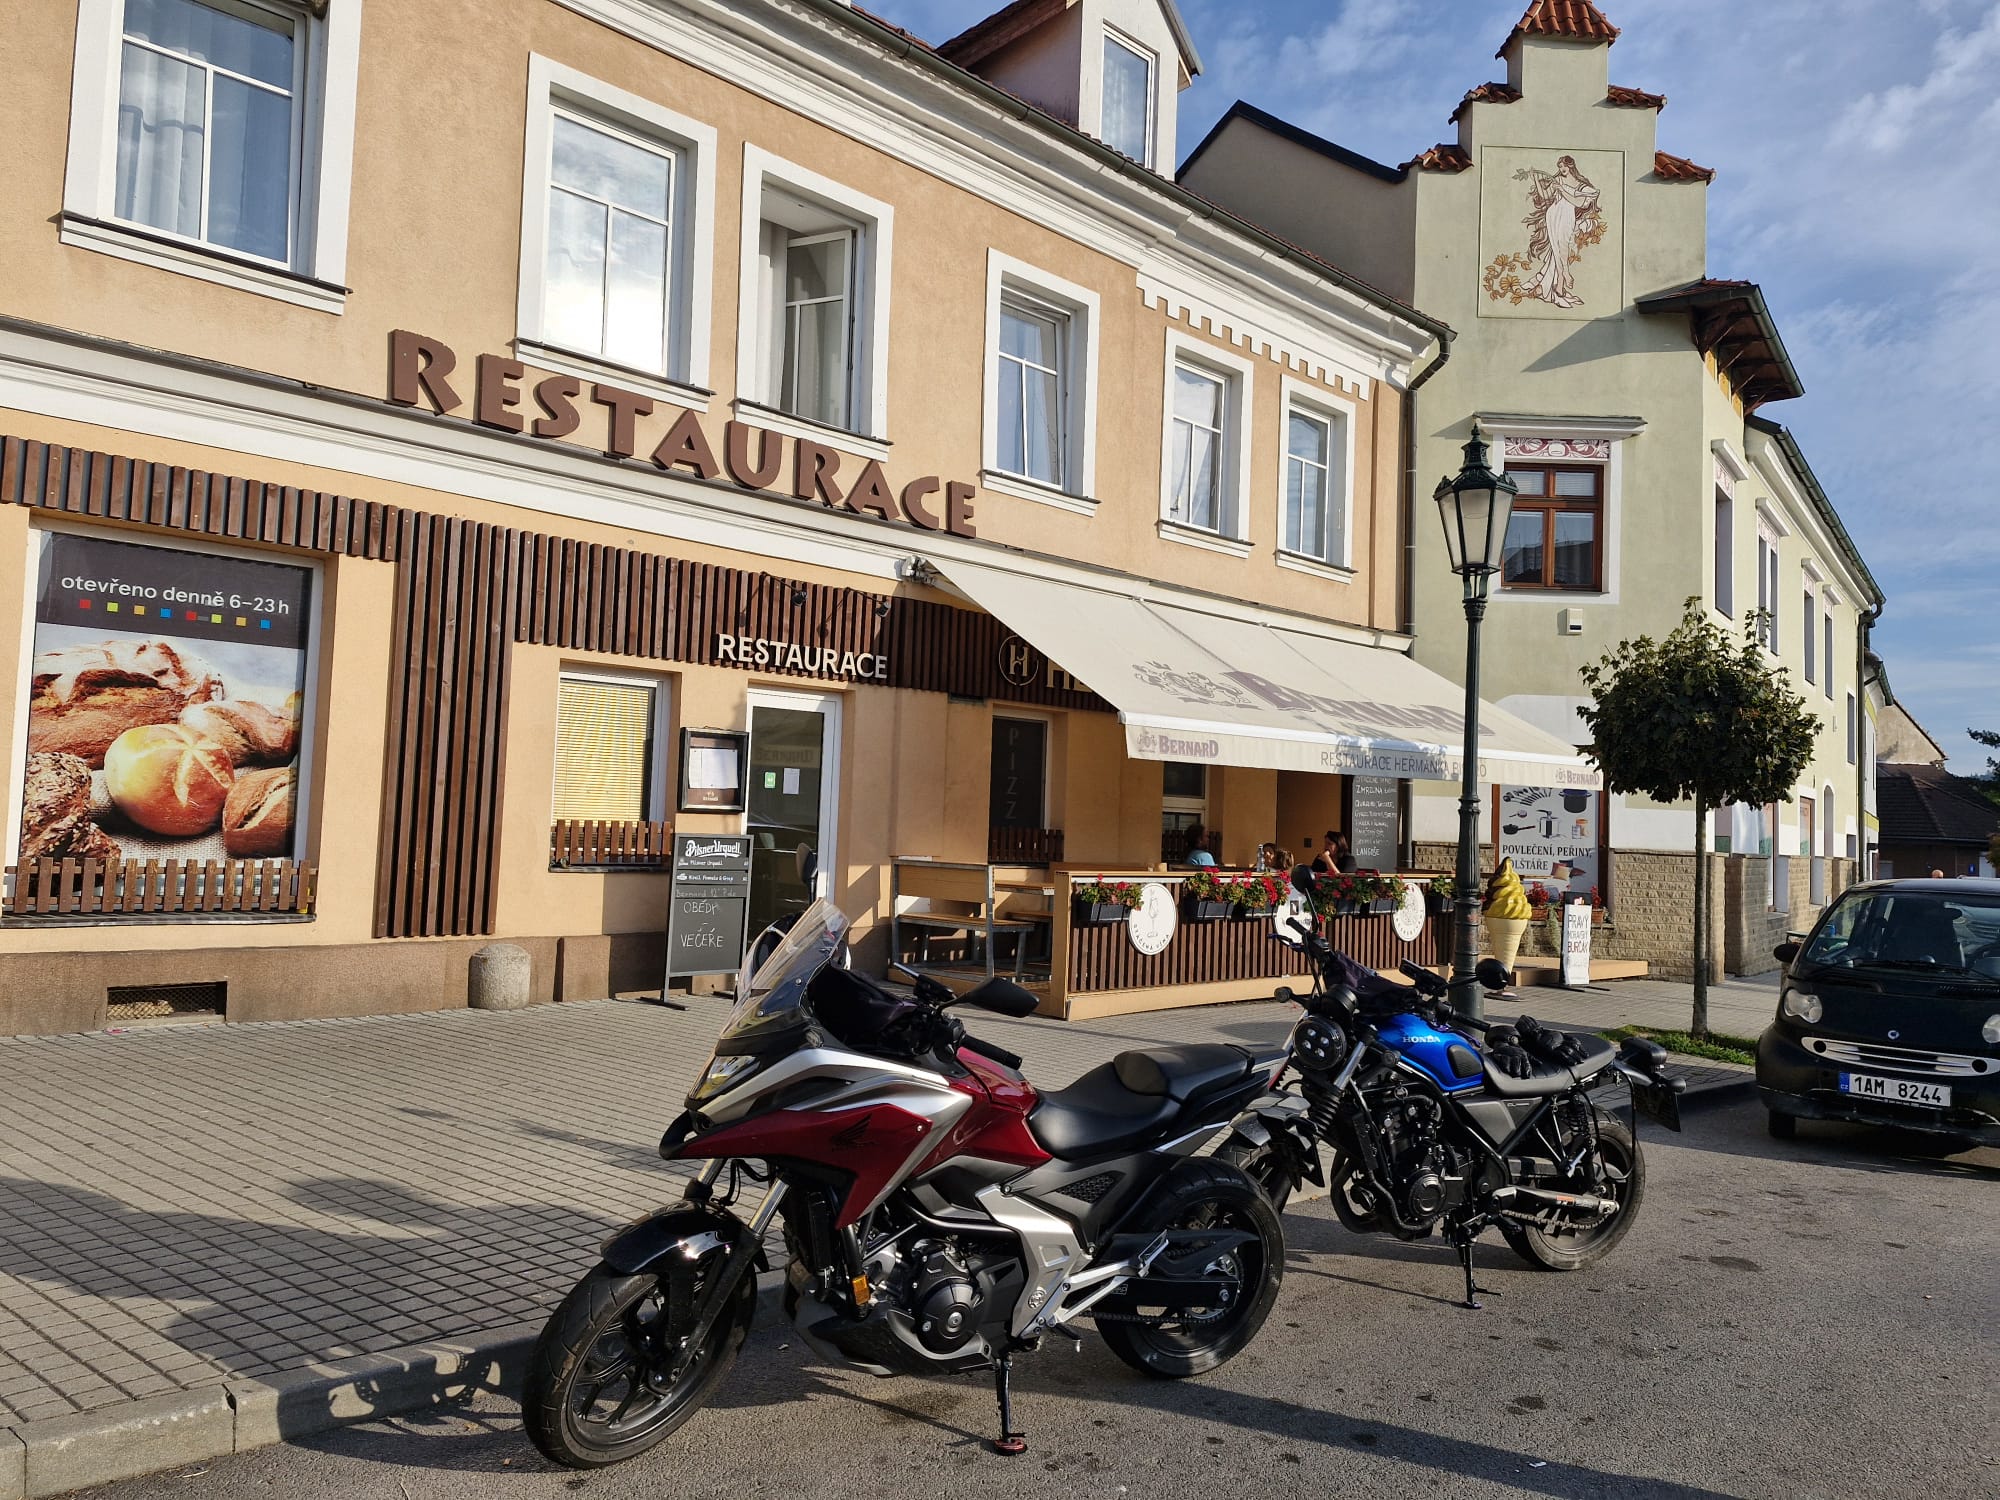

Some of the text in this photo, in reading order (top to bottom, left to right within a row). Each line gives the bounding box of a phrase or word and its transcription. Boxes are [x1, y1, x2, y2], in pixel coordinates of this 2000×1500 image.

[387, 329, 977, 538] RESTAURACE
[61, 575, 157, 599] otevřeno
[163, 586, 225, 607] denně
[717, 633, 888, 679] RESTAURACE
[1158, 734, 1219, 759] BERNARD
[1320, 751, 1391, 771] RESTAURACE
[1452, 761, 1487, 778] BIO
[1566, 769, 1600, 785] BERNARD
[685, 839, 741, 858] Pilsner Urquell
[1502, 843, 1593, 859] POVLEČENÍ, PEŘINY,
[1402, 1035, 1441, 1043] HONDA
[1854, 1076, 1942, 1103] 1AM 8244
